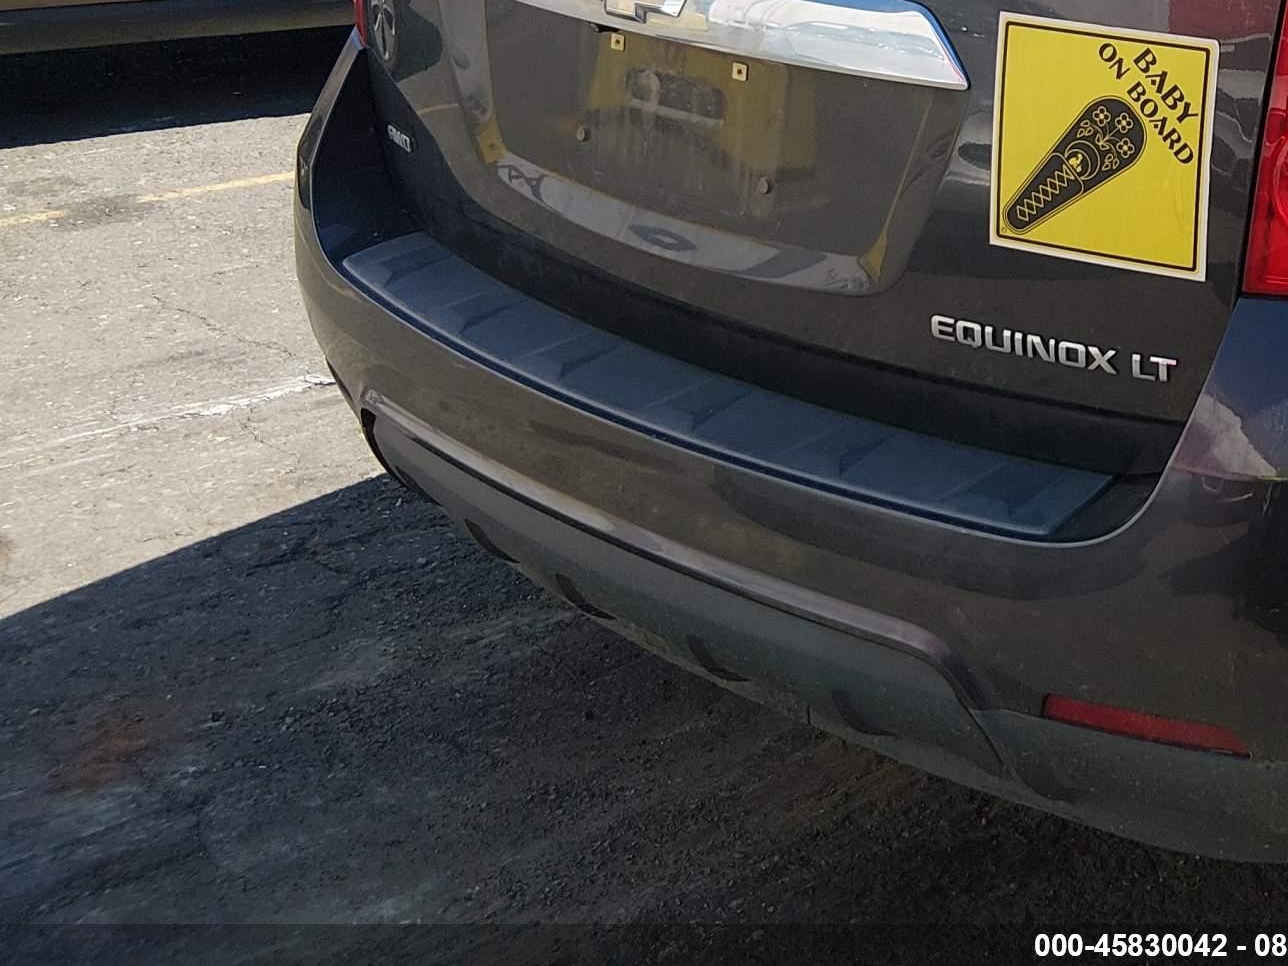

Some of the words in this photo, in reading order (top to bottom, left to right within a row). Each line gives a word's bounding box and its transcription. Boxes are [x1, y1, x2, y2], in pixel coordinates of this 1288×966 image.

[1097, 42, 1131, 81] ON
[1126, 81, 1195, 166] BOARD
[1133, 47, 1199, 122] BABY
[931, 315, 1116, 374] EQUINOX
[1131, 353, 1177, 382] LT
